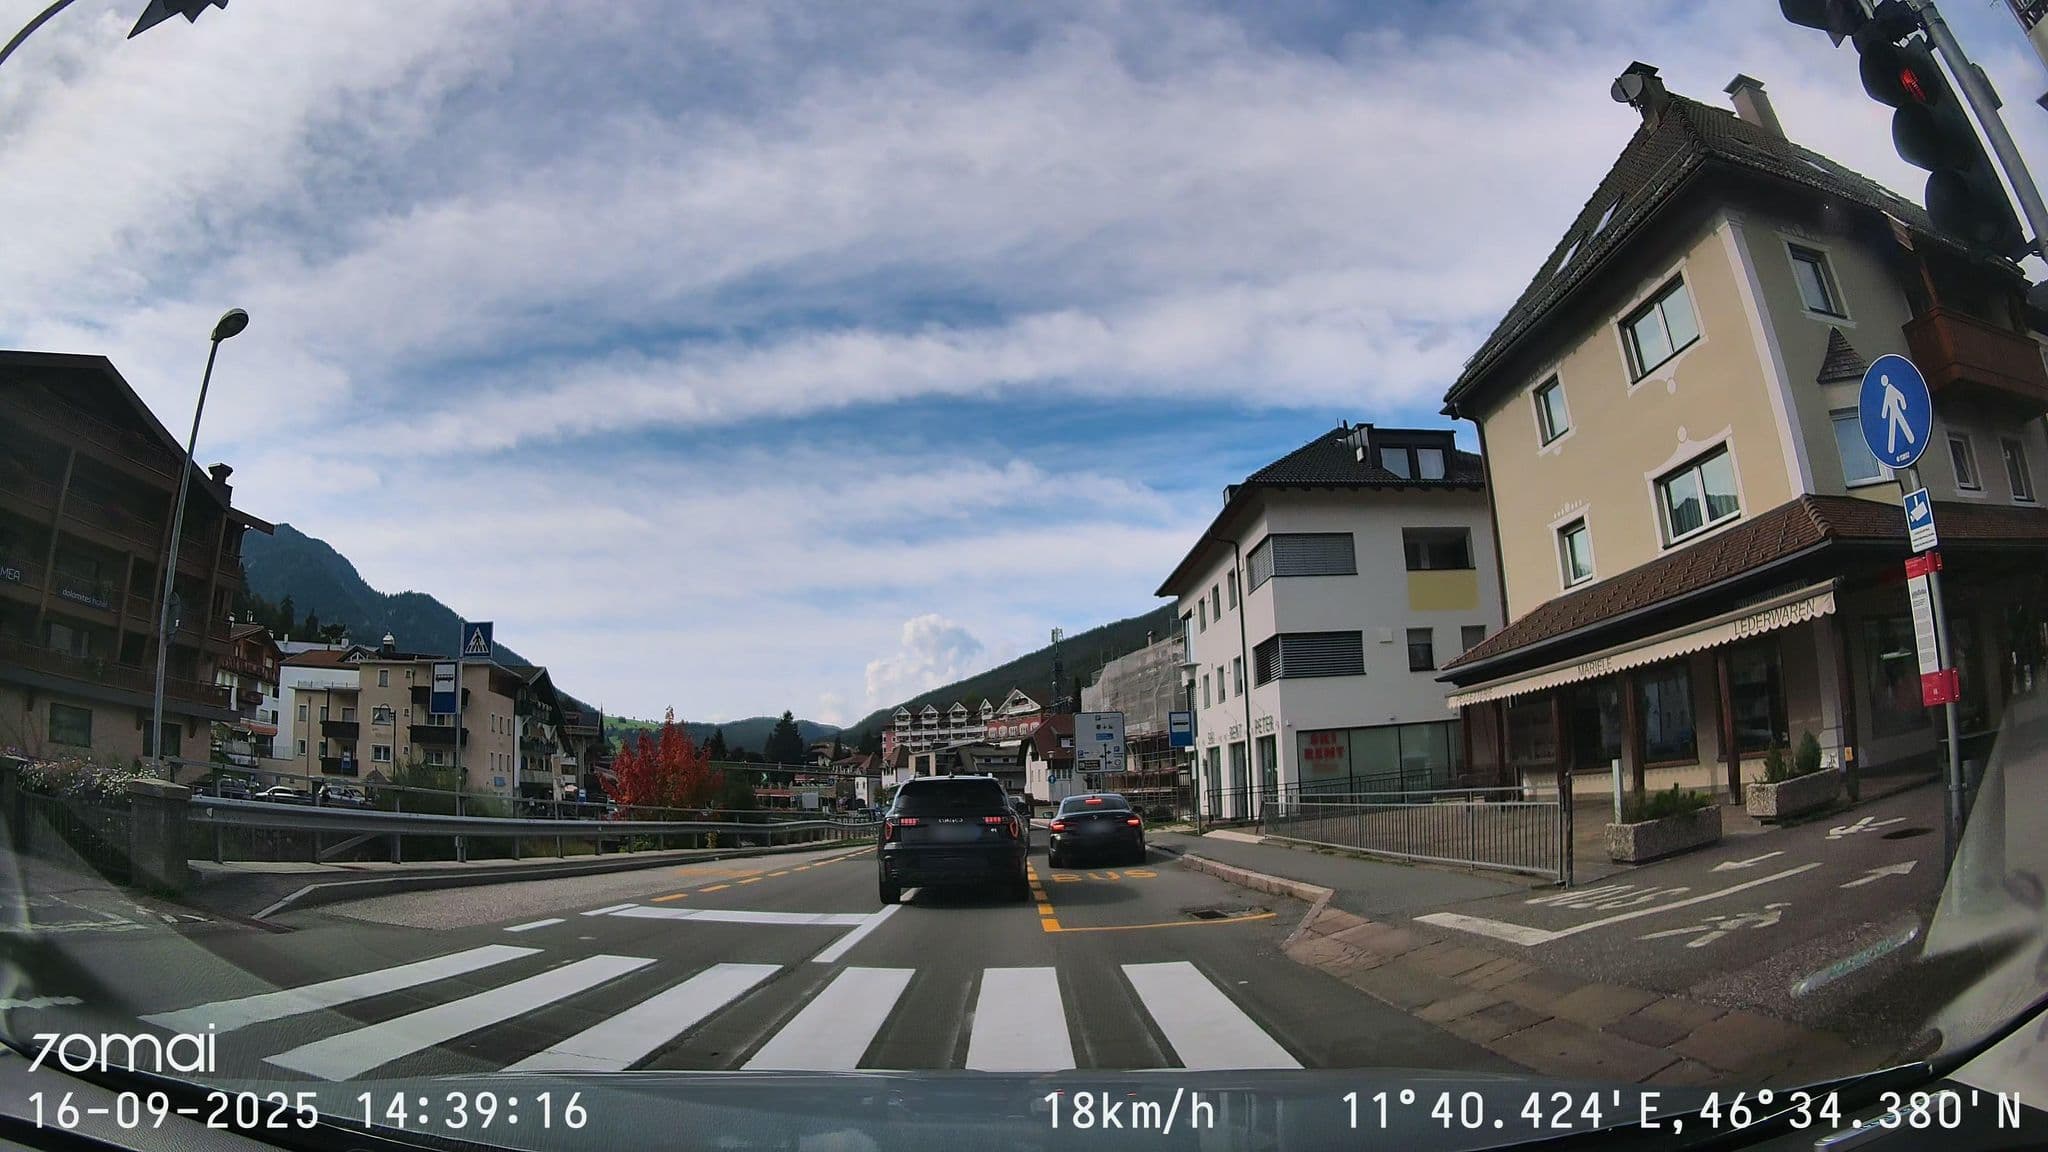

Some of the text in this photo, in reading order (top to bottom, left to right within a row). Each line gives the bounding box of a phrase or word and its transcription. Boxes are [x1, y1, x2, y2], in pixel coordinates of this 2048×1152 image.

[1733, 599, 1816, 635] LEDERWAREN
[1311, 733, 1337, 746] SKI
[1304, 746, 1345, 760] RENT
[1051, 869, 1159, 882] BUS
